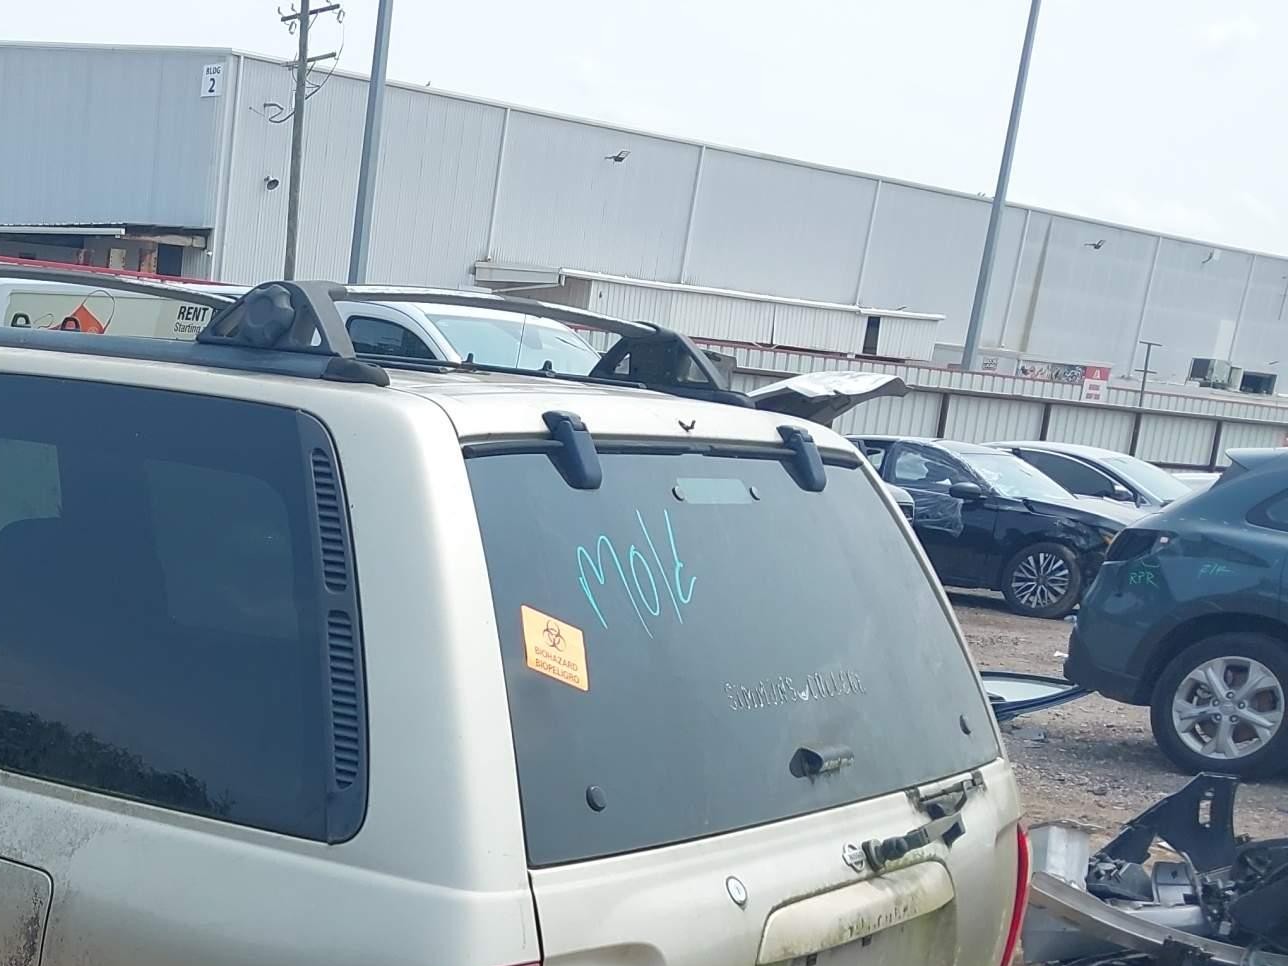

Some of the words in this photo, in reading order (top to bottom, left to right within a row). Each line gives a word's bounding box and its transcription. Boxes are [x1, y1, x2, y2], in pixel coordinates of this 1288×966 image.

[208, 77, 216, 93] 2
[177, 305, 209, 322] RENT
[534, 646, 578, 672] BIOHAZARD
[535, 658, 580, 684] BIOPELIGRO
